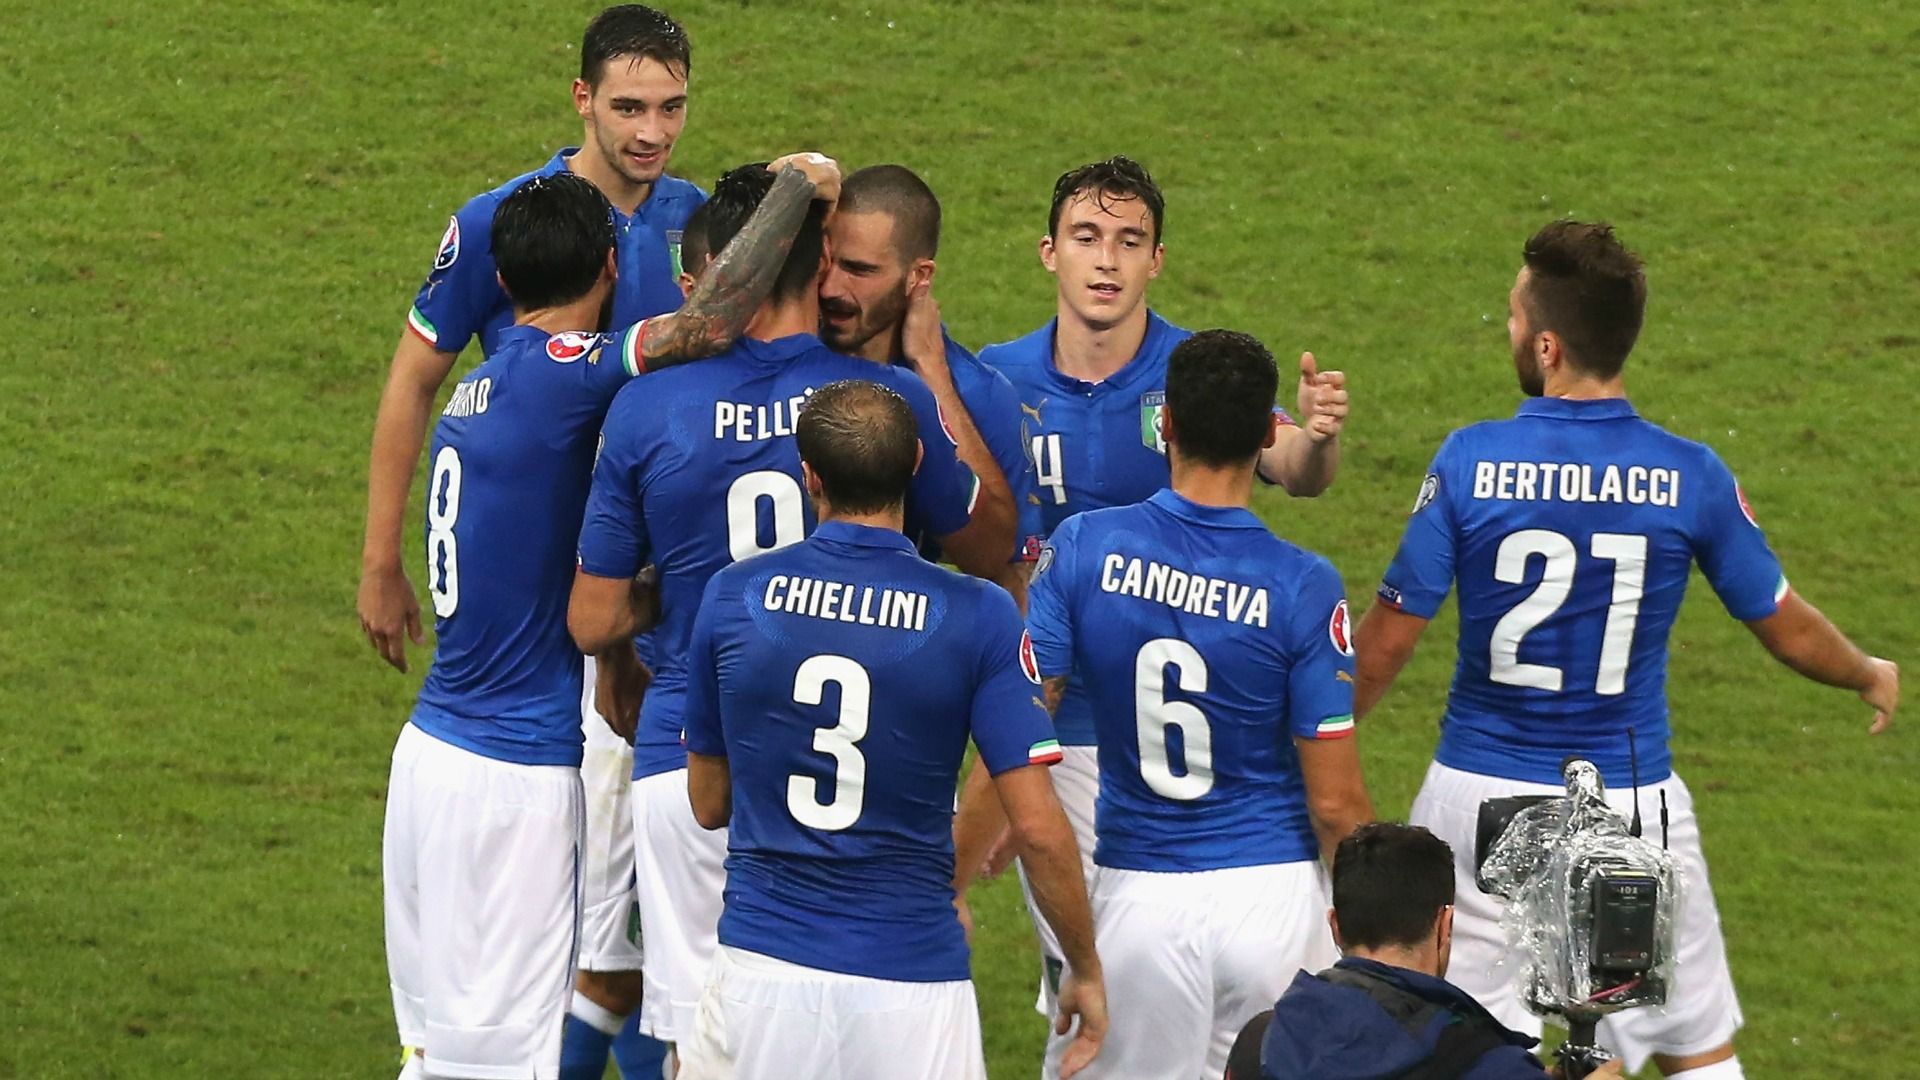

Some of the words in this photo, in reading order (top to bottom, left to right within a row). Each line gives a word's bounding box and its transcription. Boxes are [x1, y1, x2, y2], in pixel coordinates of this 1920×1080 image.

[1030, 432, 1068, 505] 4
[1473, 461, 1680, 508] BERTOLACCI
[427, 445, 462, 618] 8
[1100, 553, 1270, 628] CANDREVA
[763, 575, 929, 632] CHIELLINI
[1489, 529, 1648, 695] 21
[786, 654, 871, 831] 3
[1135, 638, 1214, 800] 6
